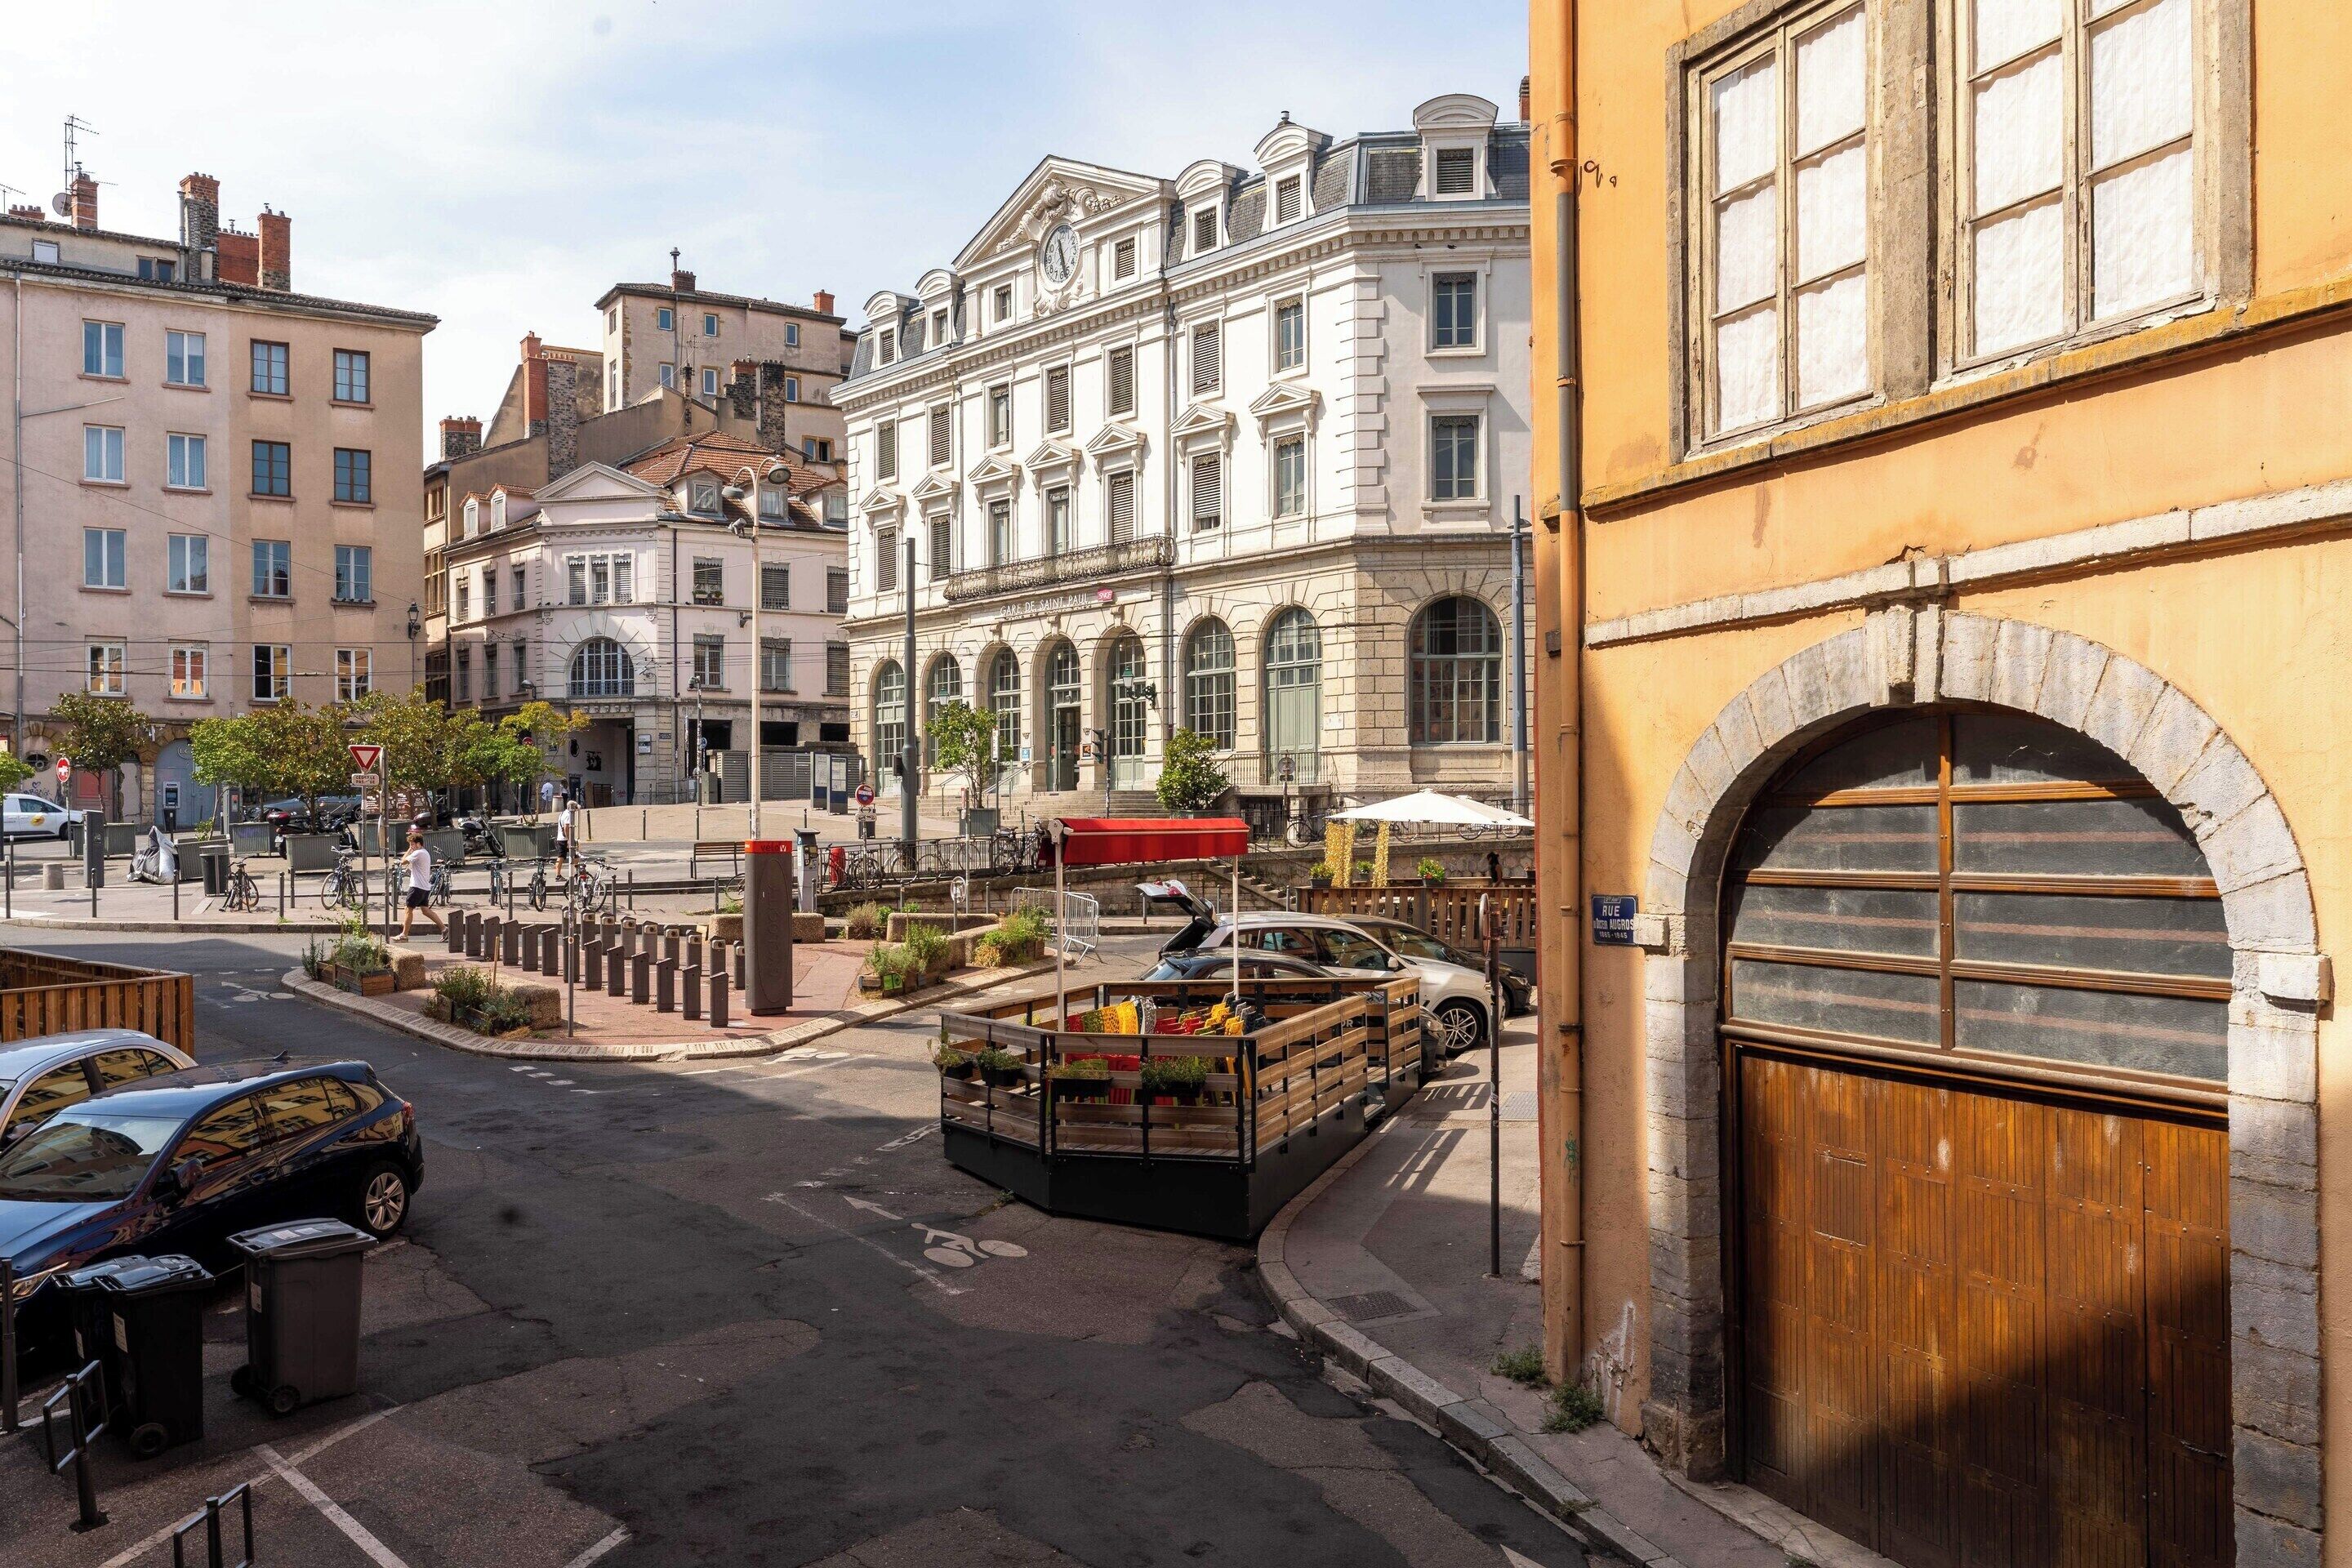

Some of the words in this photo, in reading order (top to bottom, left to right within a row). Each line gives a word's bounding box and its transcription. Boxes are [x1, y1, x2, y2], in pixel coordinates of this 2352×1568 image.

[1048, 255, 1052, 264] 9
[1049, 265, 1054, 274] 8
[1054, 270, 1058, 280] 7
[1060, 270, 1064, 280] 6
[1098, 591, 1112, 600] SNCF
[1000, 603, 1021, 617] GARE
[1025, 601, 1036, 612] DE
[1039, 596, 1064, 611] SAINT
[1068, 593, 1089, 607] PAUL
[1602, 906, 1620, 916] RUE
[1609, 919, 1634, 930] AUGROS
